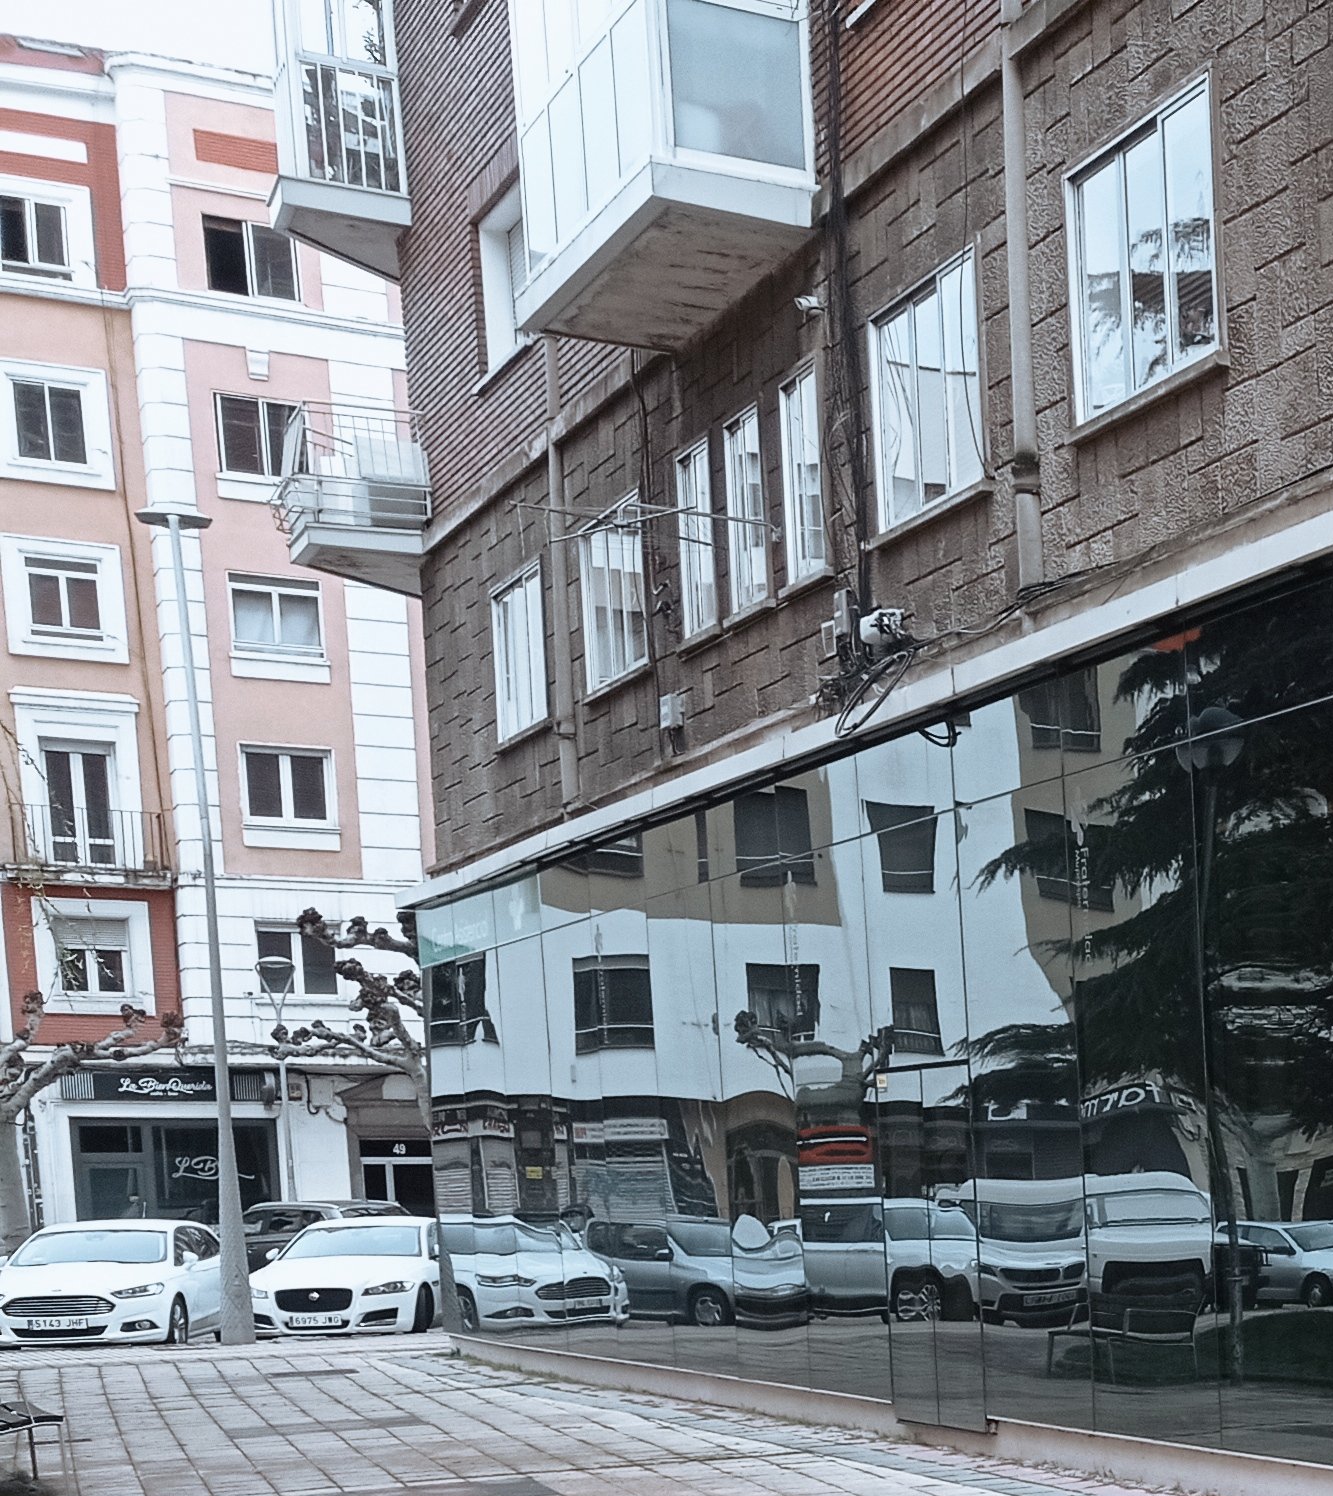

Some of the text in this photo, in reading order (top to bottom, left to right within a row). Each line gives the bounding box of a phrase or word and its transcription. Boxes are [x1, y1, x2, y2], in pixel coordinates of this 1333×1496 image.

[392, 1143, 407, 1155] 49
[65, 1318, 84, 1328] JHF
[295, 1316, 319, 1326] 6975
